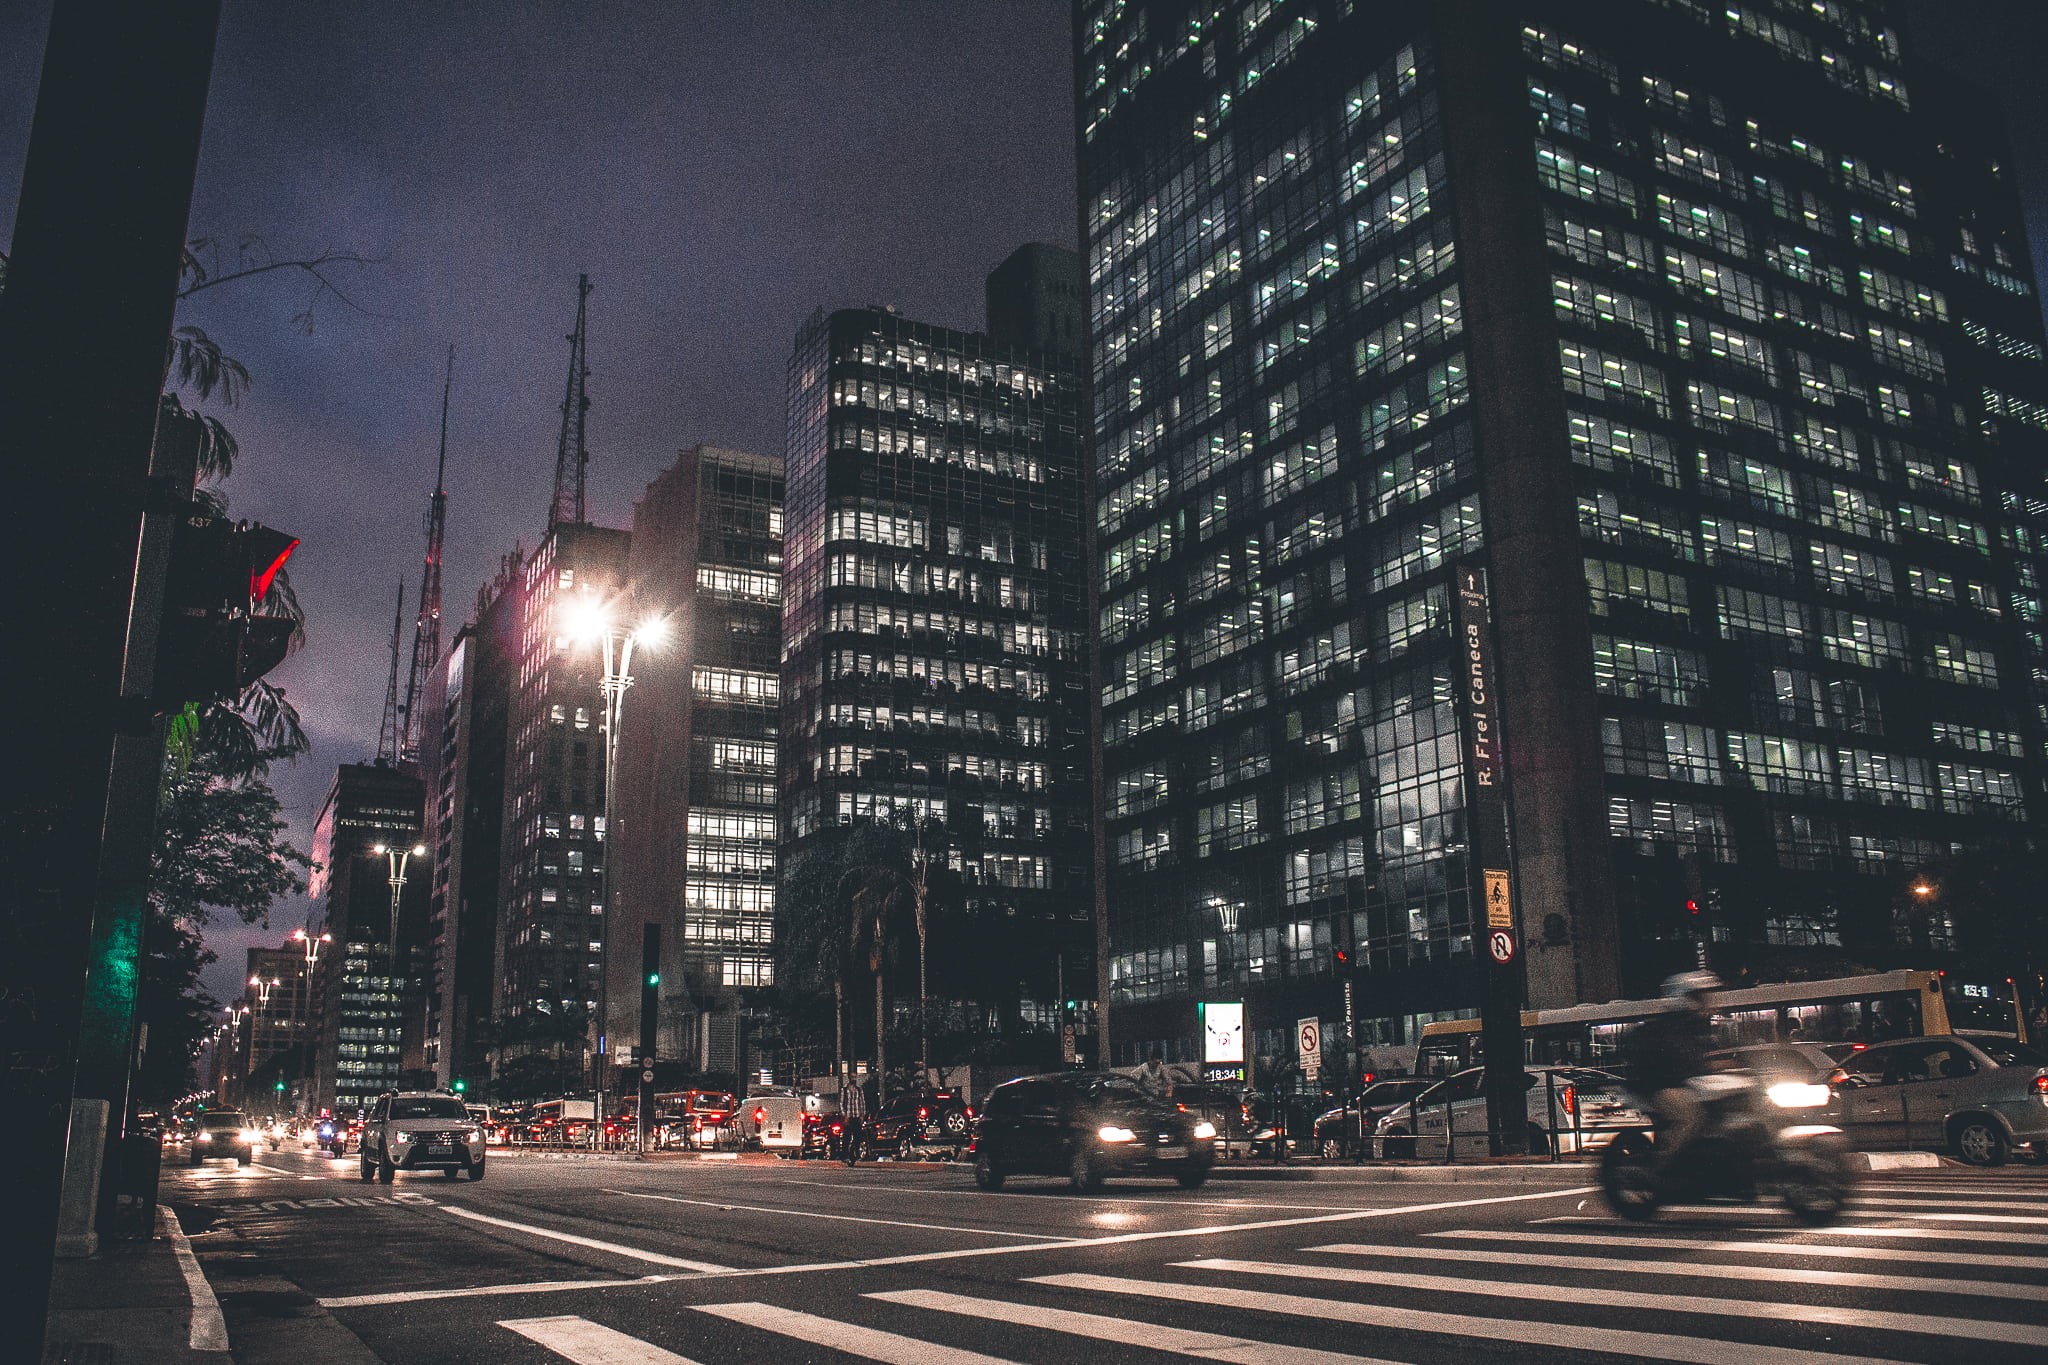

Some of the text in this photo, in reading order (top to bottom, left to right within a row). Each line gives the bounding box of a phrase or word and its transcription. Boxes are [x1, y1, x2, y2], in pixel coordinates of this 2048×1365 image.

[1467, 623, 1493, 787] R. Frei Caneca
[1344, 982, 1352, 1023] Paulista
[1209, 1069, 1236, 1081] 18:34
